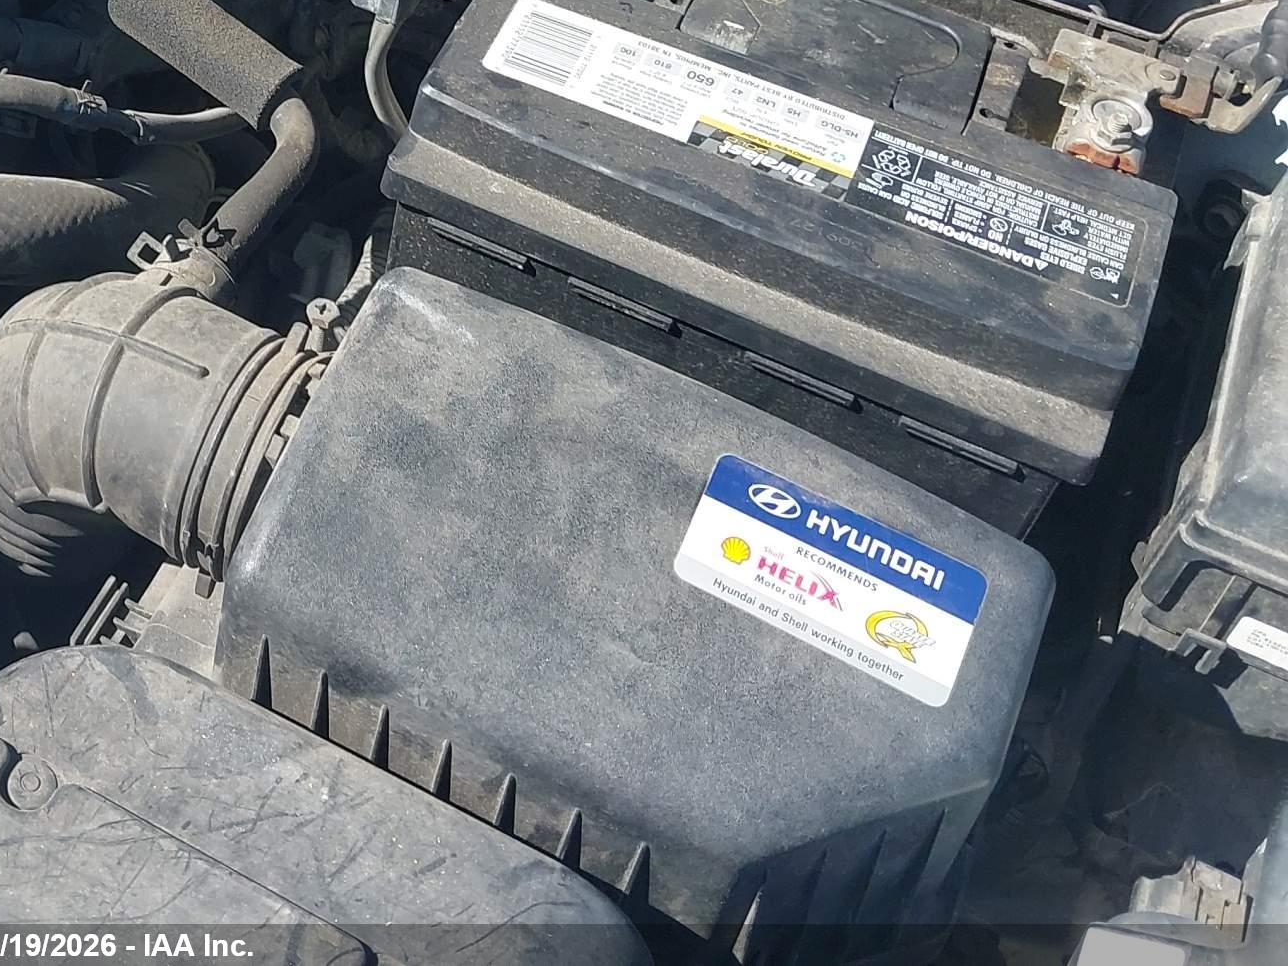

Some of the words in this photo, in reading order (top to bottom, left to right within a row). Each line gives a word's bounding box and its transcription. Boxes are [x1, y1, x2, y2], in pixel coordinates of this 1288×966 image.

[685, 69, 715, 87] 650
[730, 86, 744, 96] 47
[760, 84, 781, 96] BEST
[793, 97, 845, 120] DISTRIBUTED
[725, 134, 769, 155] GOLD
[716, 138, 819, 187] Duralast
[1033, 188, 1044, 197] OF
[1044, 192, 1069, 206] REACH
[1071, 213, 1088, 224] HELP
[1086, 207, 1097, 217] OF
[1098, 211, 1114, 223] OUT
[1114, 217, 1134, 230] KEEP
[904, 209, 1035, 267] DANGER/POISON
[986, 228, 1004, 242] NO
[1039, 251, 1059, 264] EYES
[1047, 245, 1087, 266] EXPLOSIVE
[1086, 251, 1109, 265] CAUSE
[1109, 259, 1124, 270] CAN
[804, 508, 946, 592] HYUNDAI
[795, 545, 879, 592] RECOMMENDS
[753, 572, 788, 596] Motor
[787, 589, 808, 606] oils
[758, 555, 843, 611] HELIX
[711, 576, 756, 609] Hyundai
[757, 599, 780, 619] and
[780, 611, 808, 633] Shell
[809, 626, 855, 658] working
[855, 649, 905, 684] together
